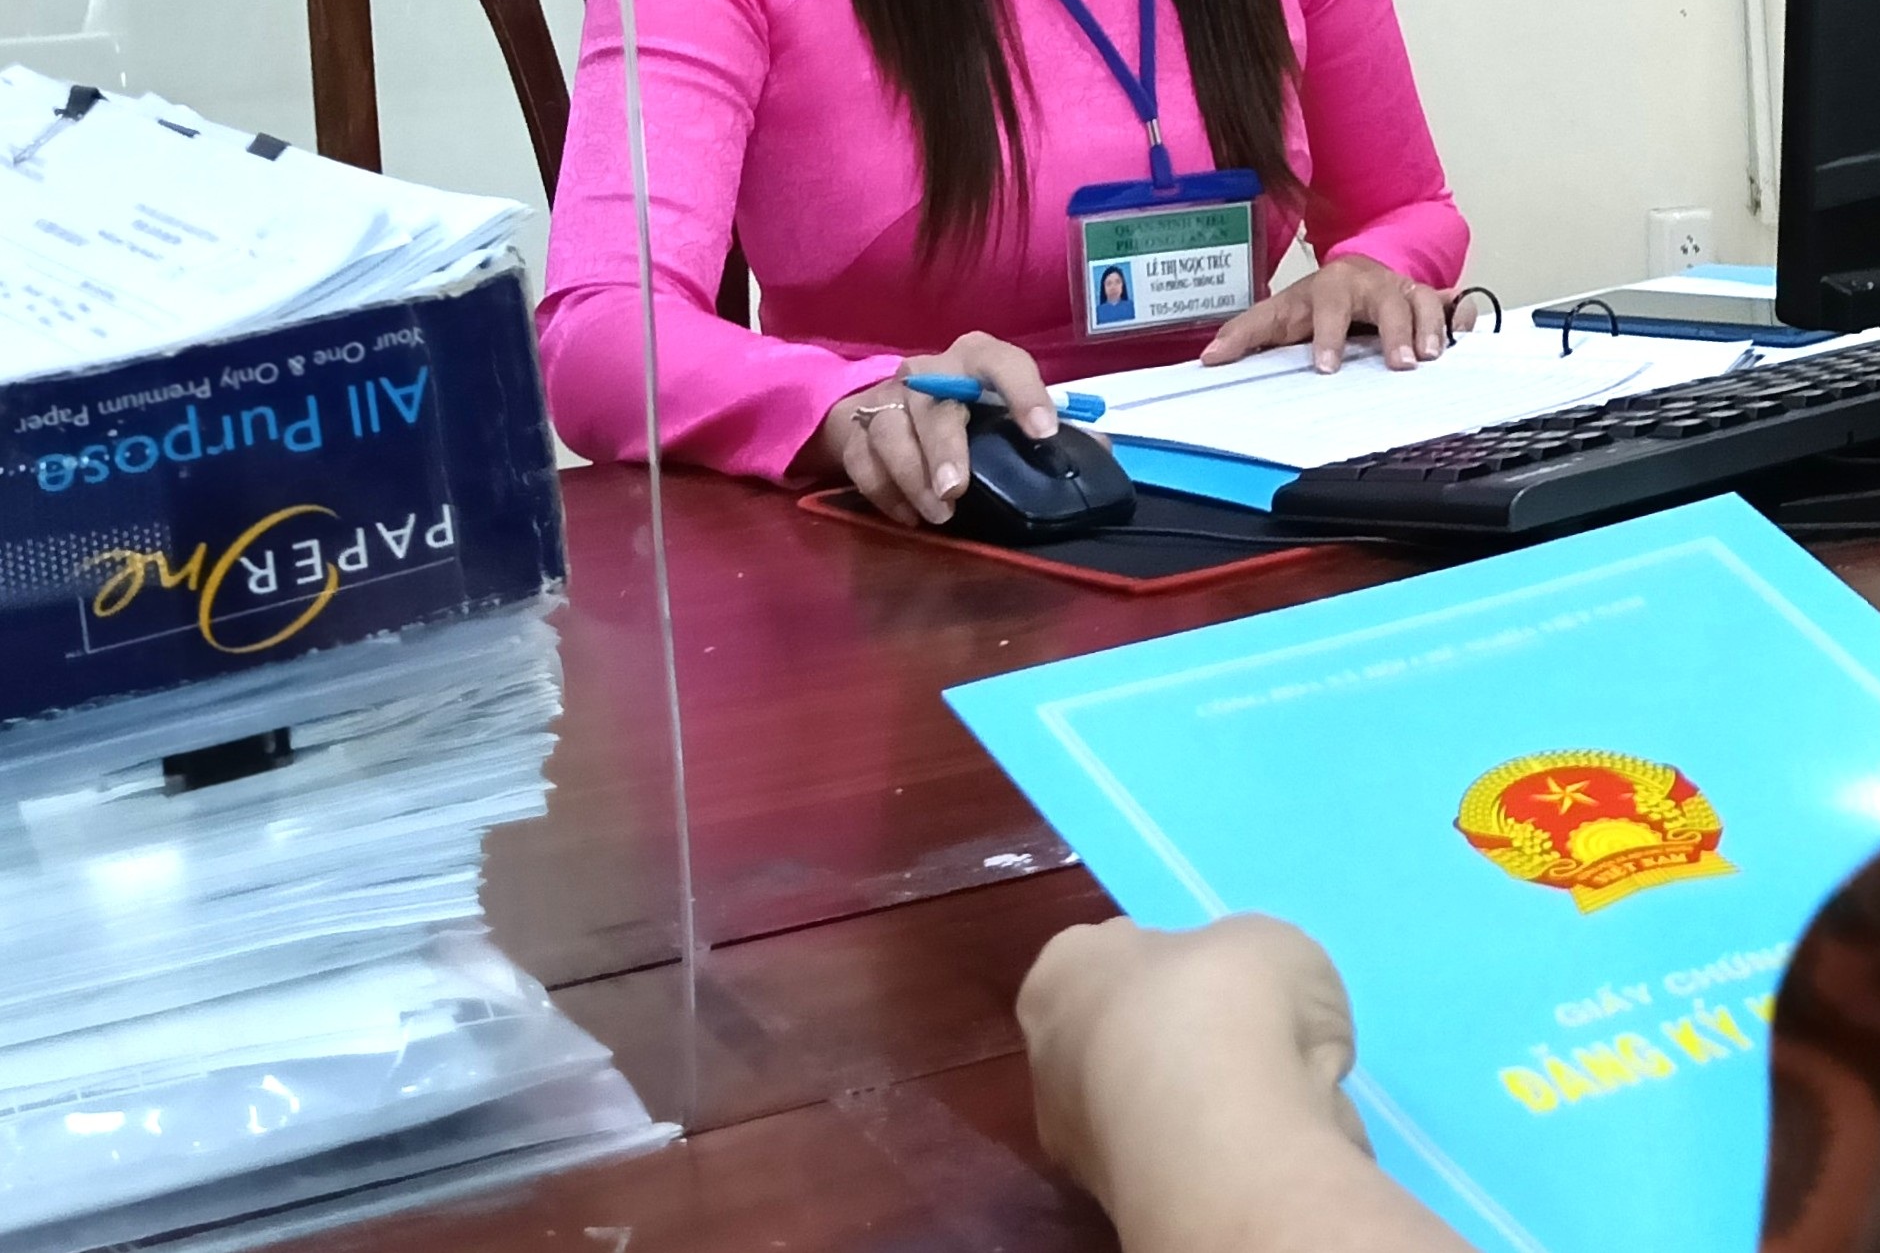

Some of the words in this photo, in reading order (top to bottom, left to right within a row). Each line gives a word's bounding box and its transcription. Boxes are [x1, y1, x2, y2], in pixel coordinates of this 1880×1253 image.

[1206, 250, 1231, 270] TRÚC
[313, 341, 365, 365] One
[373, 326, 425, 351] Your
[220, 362, 279, 390] Only
[288, 355, 306, 376] &
[98, 377, 212, 415] Premium
[347, 364, 428, 437] All
[14, 404, 90, 434] Paper
[36, 394, 322, 492] Purpose
[240, 503, 455, 595] PAPER
[76, 504, 341, 653] One
[1660, 996, 1756, 1066] KÝ
